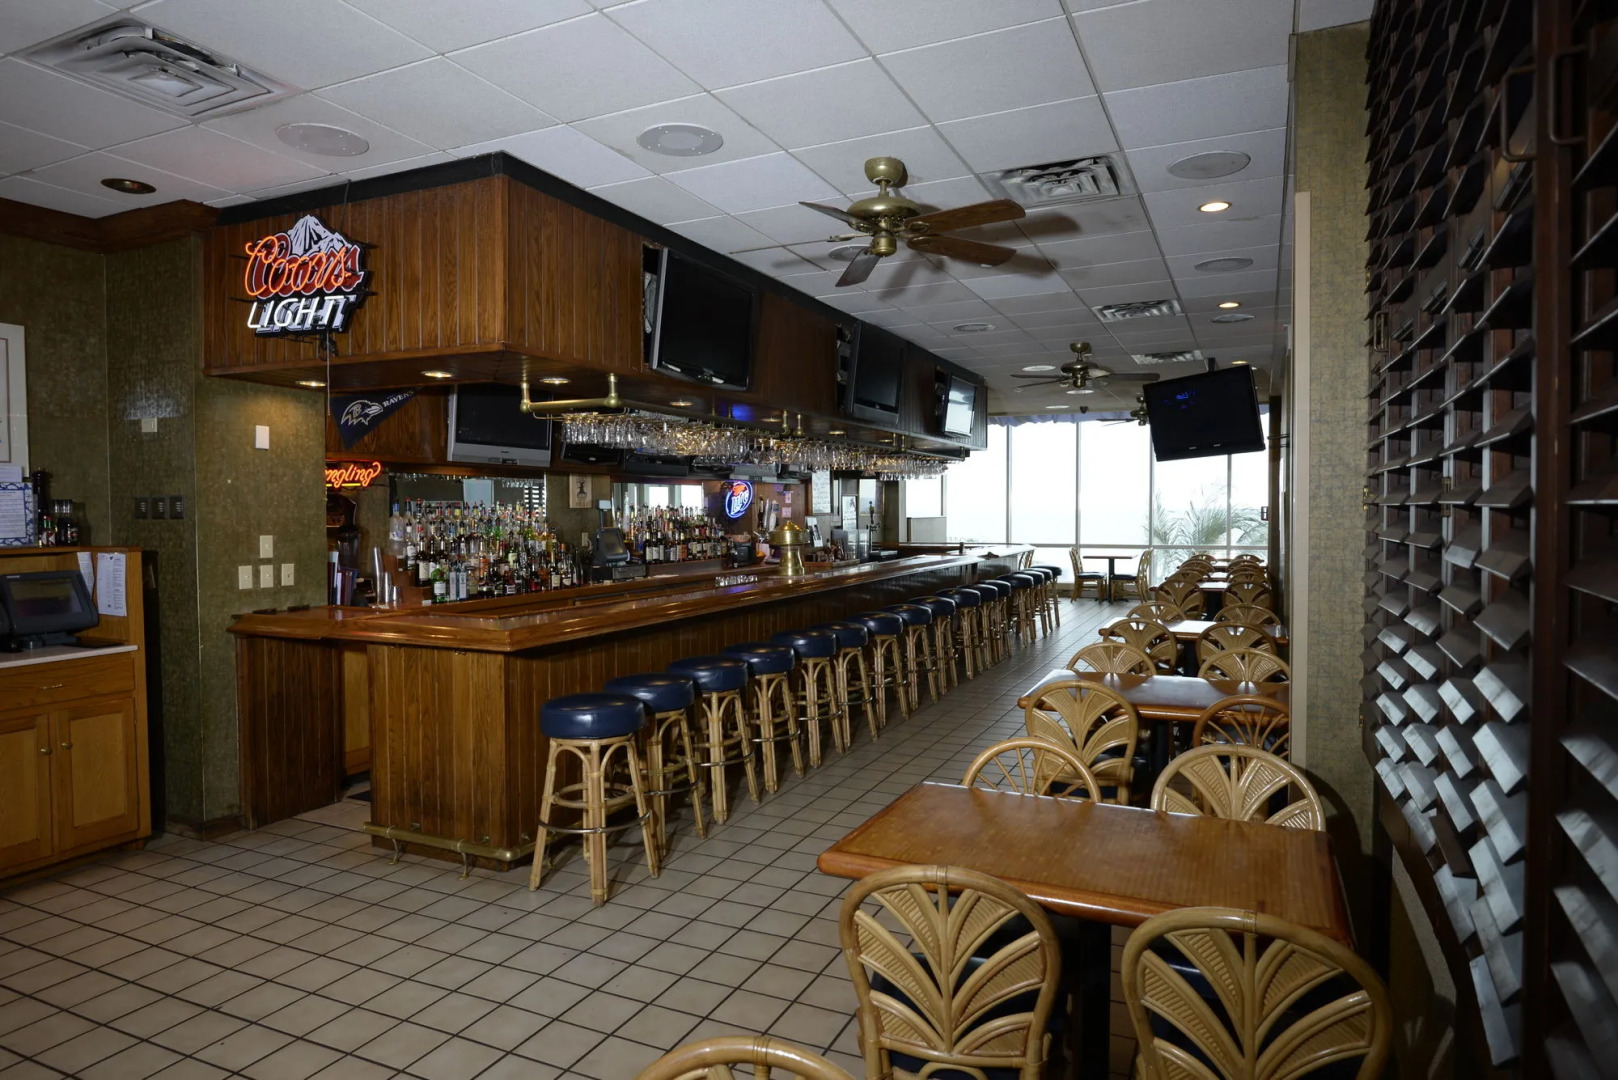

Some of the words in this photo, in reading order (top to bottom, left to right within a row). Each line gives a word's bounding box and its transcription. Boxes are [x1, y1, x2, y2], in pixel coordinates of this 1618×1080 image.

[245, 233, 364, 299] Coors
[247, 294, 356, 333] LIGHT
[325, 461, 381, 489] ngling
